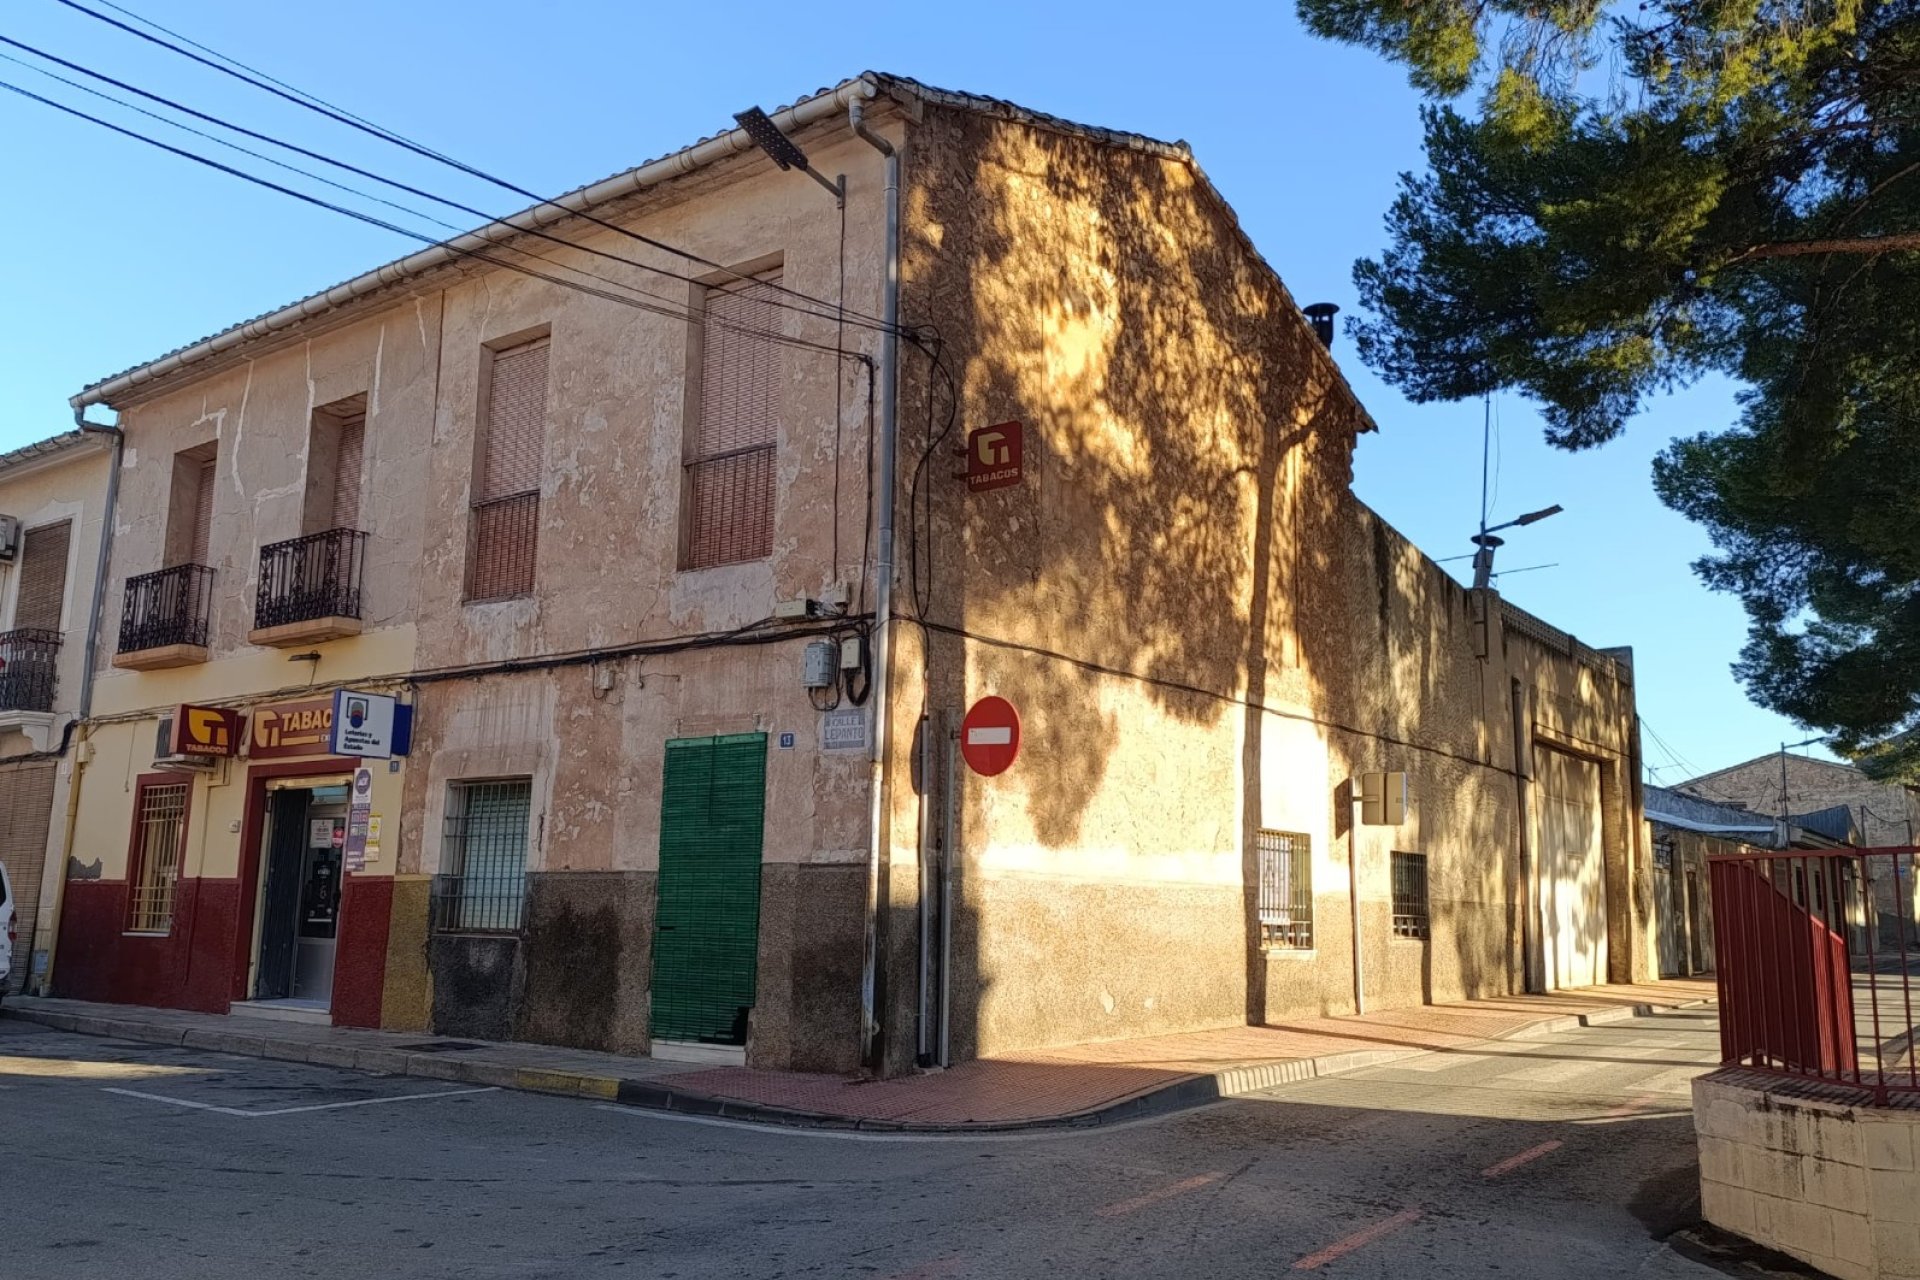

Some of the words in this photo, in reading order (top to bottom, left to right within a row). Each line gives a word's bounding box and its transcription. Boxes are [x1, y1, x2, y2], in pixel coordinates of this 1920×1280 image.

[969, 467, 1019, 485] TABACOS
[832, 716, 858, 727] CALLE
[825, 726, 864, 740] LEPANTO
[782, 735, 791, 746] 13
[186, 743, 228, 754] TABACOS
